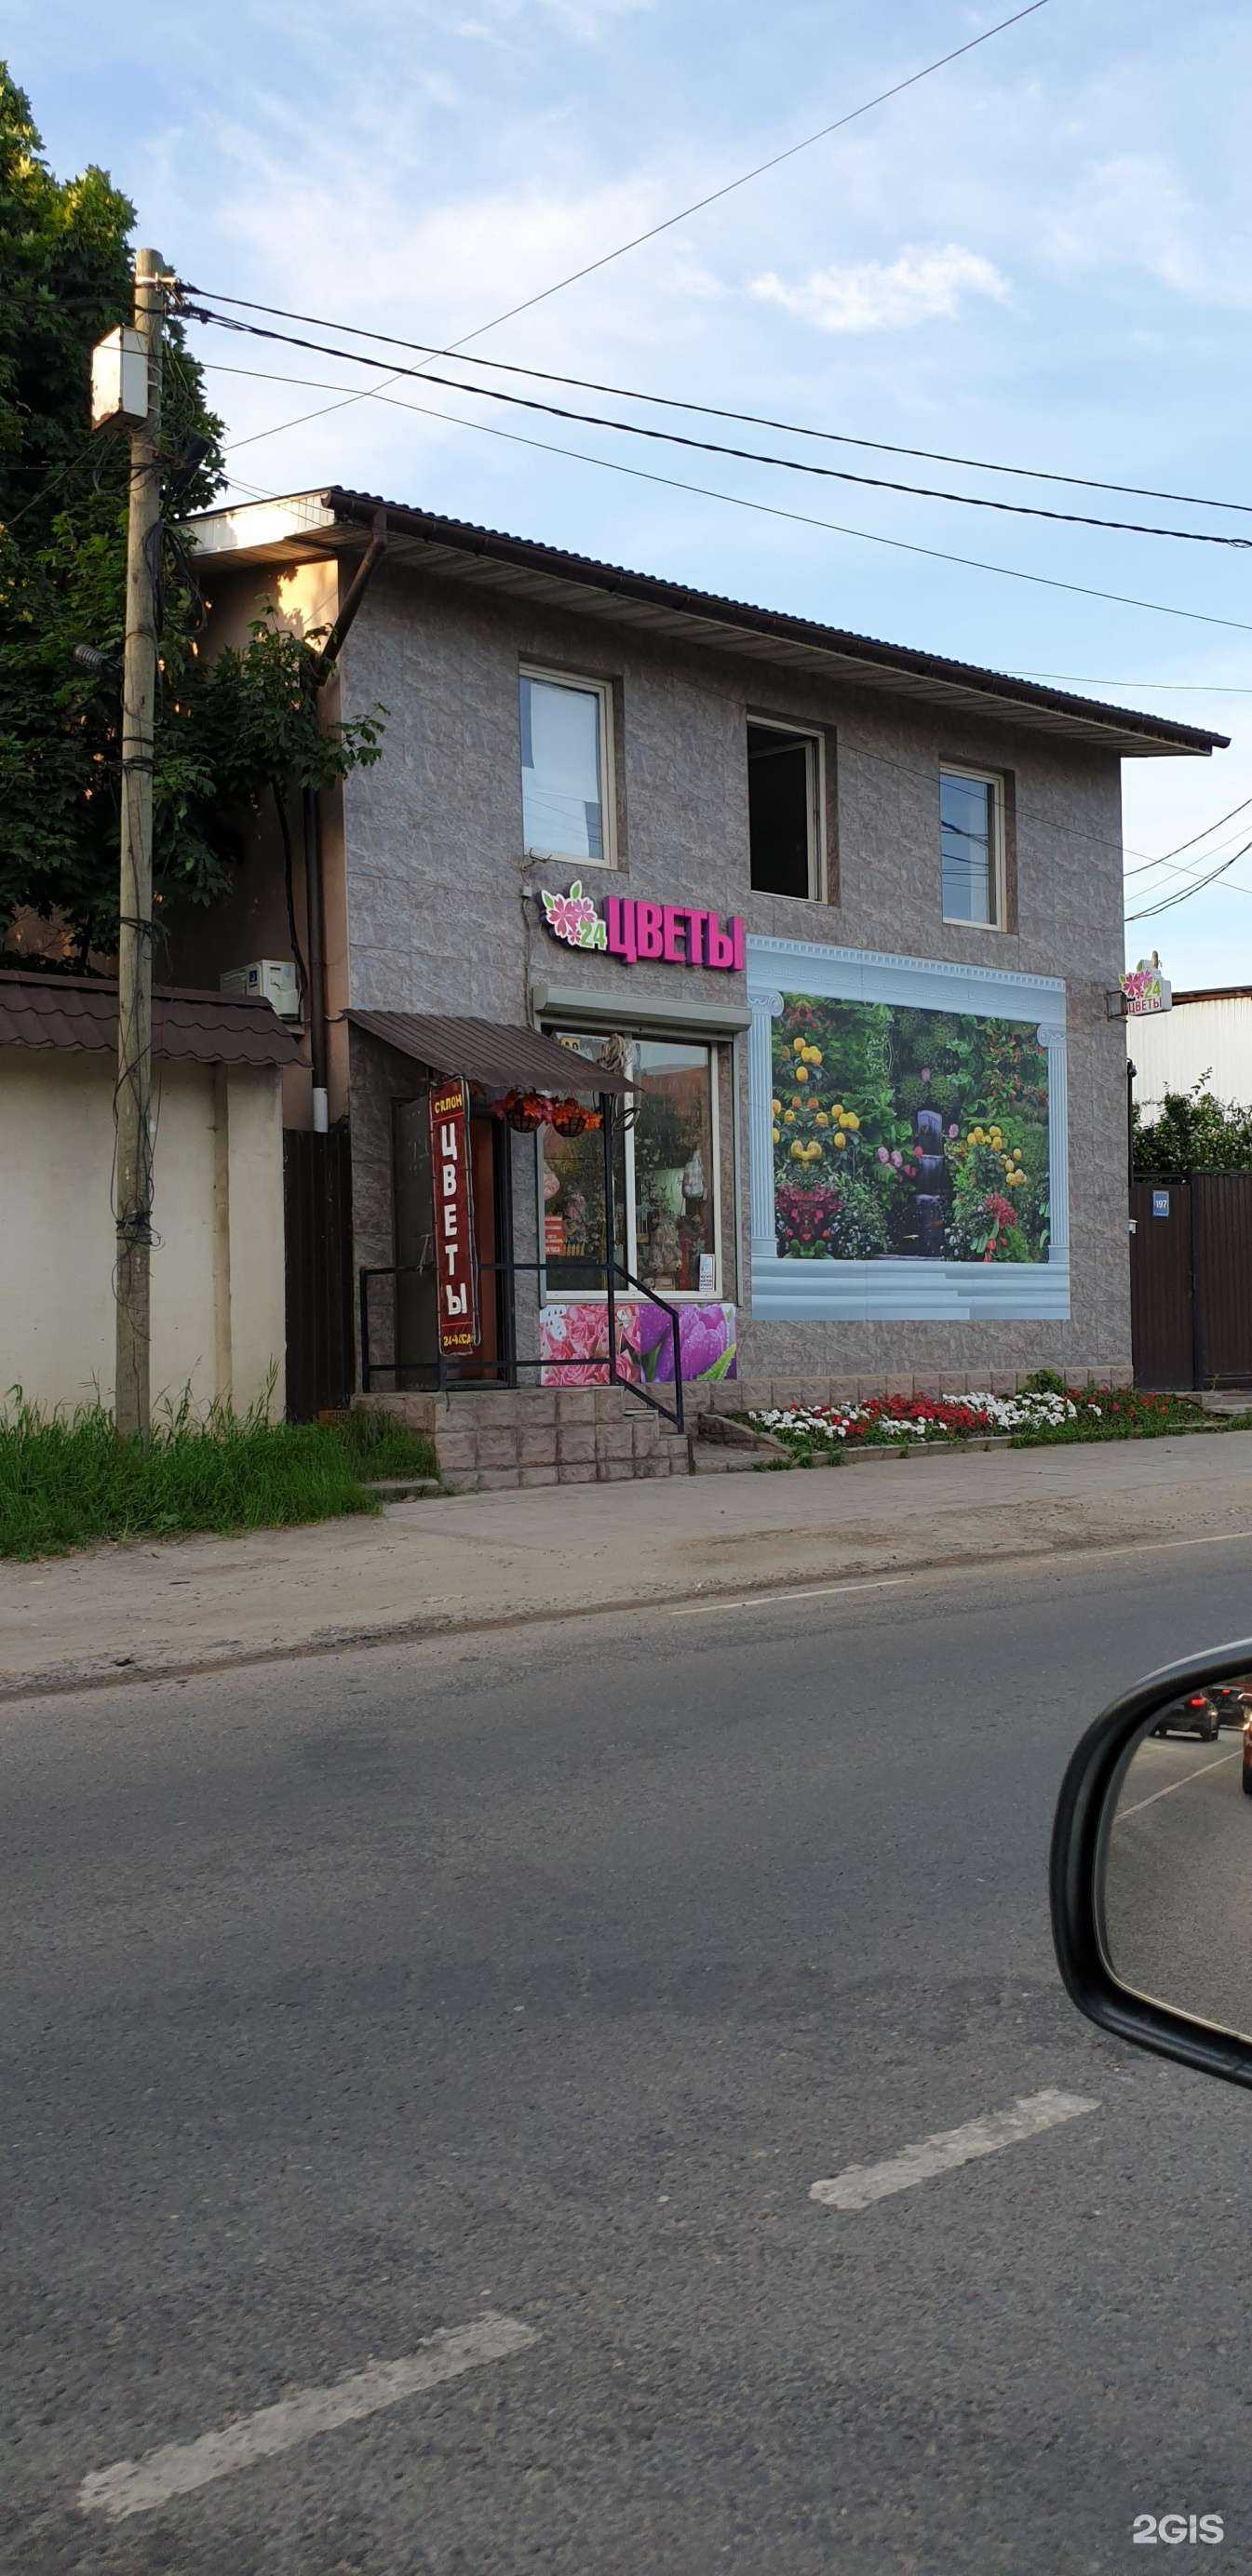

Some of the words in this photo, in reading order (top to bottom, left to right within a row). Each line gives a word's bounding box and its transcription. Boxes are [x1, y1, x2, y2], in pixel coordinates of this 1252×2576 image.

[578, 921, 607, 949] 24
[606, 895, 746, 971] ЦВЕТЫ
[1143, 979, 1162, 998] 24
[1128, 996, 1162, 1013] ЦВЕТЫ
[434, 1093, 463, 1114] САЛОН
[1154, 1195, 1167, 1209] 197
[440, 1122, 468, 1315] ЦВЕТЫ
